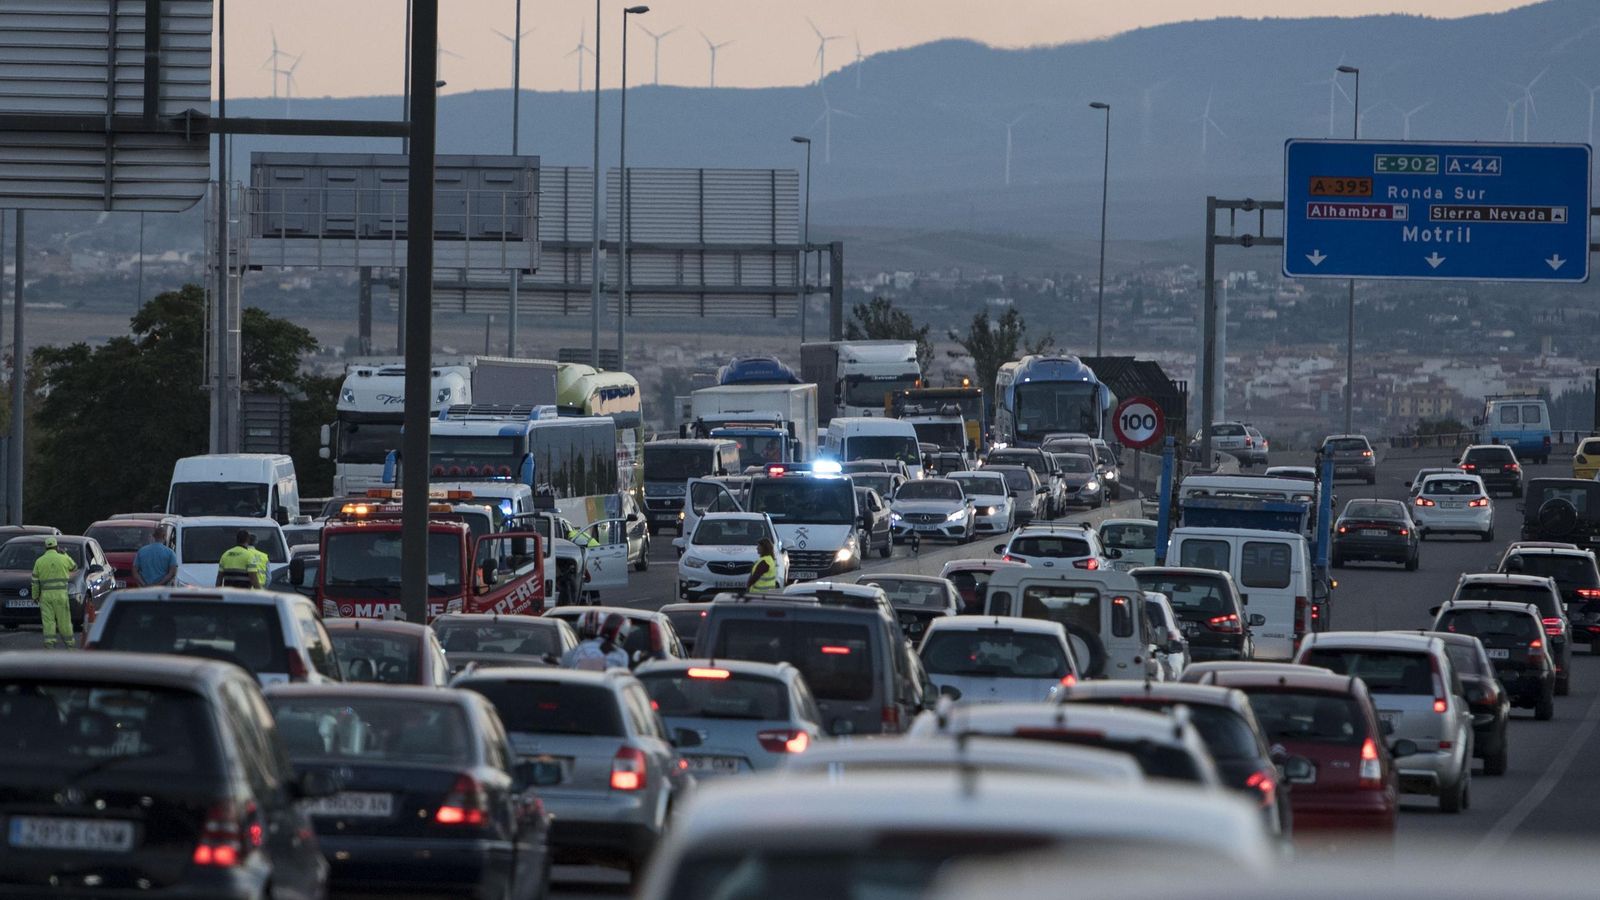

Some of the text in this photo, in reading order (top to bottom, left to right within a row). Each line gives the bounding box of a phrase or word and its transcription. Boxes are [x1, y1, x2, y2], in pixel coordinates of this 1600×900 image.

[1376, 157, 1437, 172] E-902
[1449, 158, 1499, 173] A-44
[1312, 179, 1370, 194] A-395
[1387, 185, 1486, 200] Ronda Sur
[1310, 204, 1387, 219] Alhambra
[1432, 206, 1546, 221] Sierra Nevada
[1402, 226, 1471, 244] Motril
[1121, 414, 1156, 431] 100
